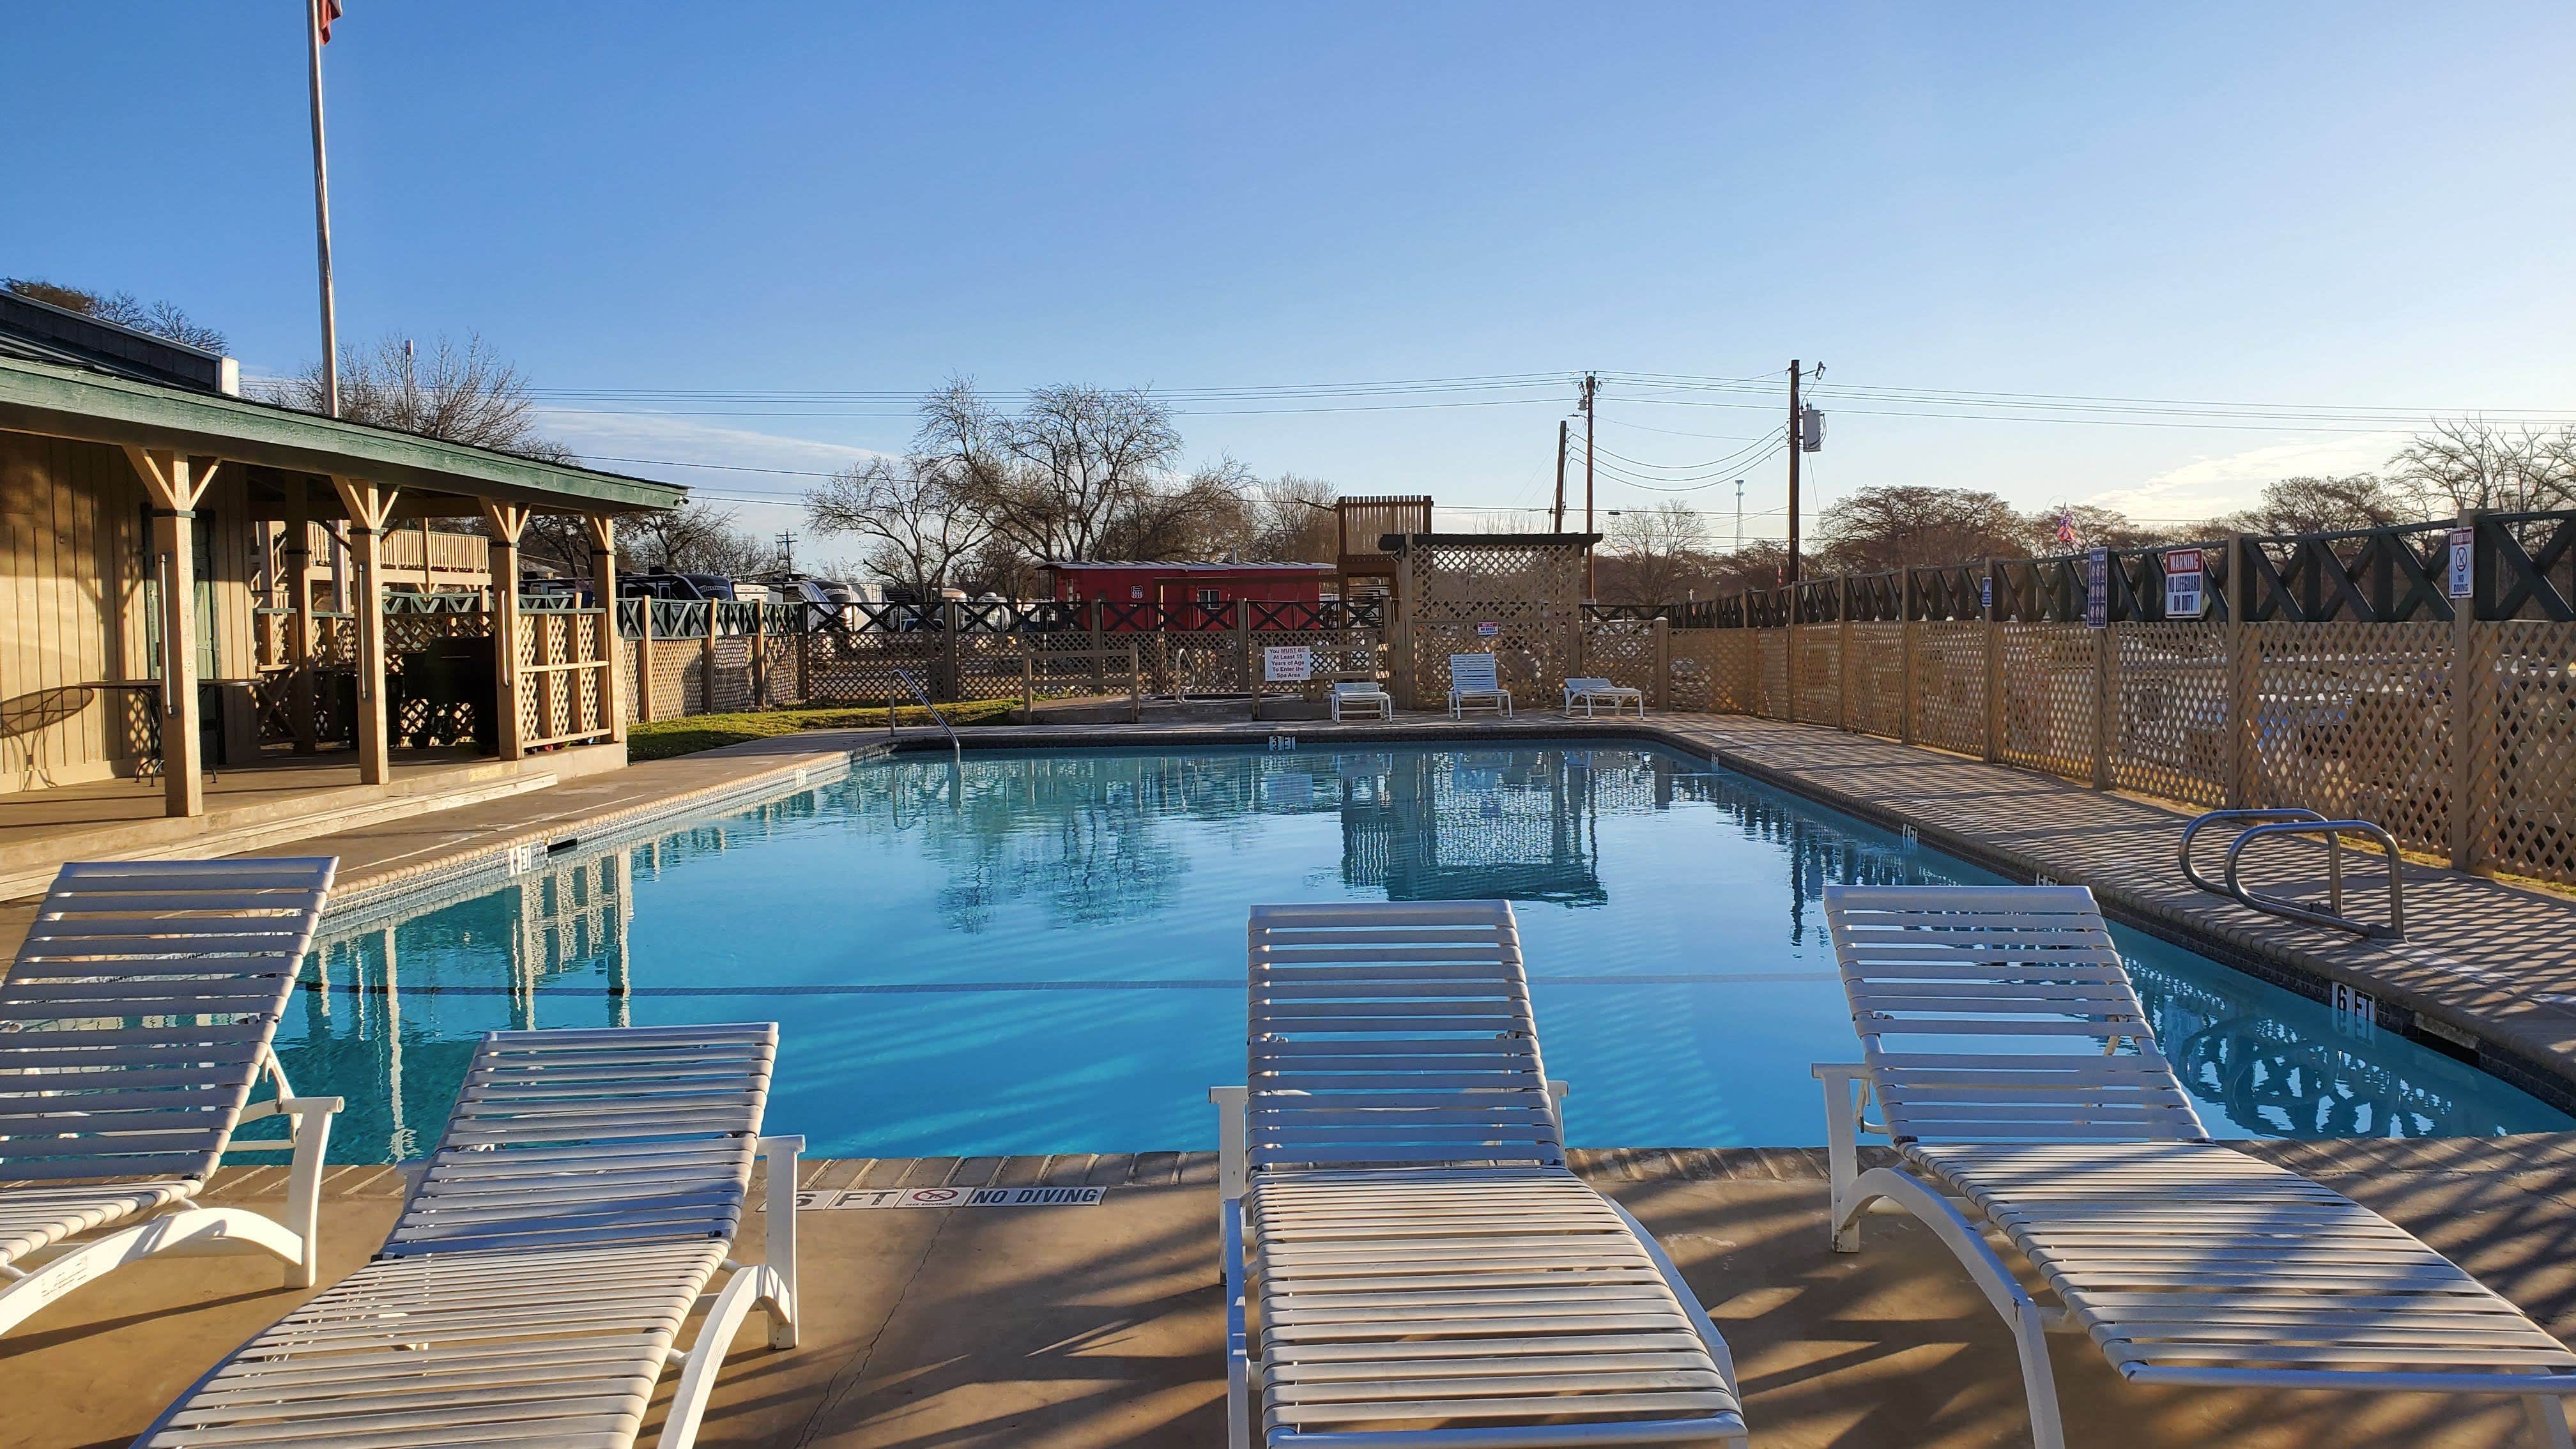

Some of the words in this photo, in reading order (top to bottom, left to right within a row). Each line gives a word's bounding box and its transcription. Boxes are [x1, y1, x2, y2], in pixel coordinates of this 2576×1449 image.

[2170, 553, 2198, 571] WARNING
[2168, 576, 2174, 593] NO
[2175, 575, 2200, 592] LIFEGUARD
[2453, 583, 2468, 592] DIVING
[2458, 574, 2464, 583] NO
[2174, 595, 2180, 611] ON
[2182, 594, 2193, 611] DUTY
[2337, 985, 2347, 1011] 6
[2354, 990, 2373, 1021] FT
[834, 1191, 898, 1207] FT
[972, 1190, 1009, 1204] NO
[1015, 1188, 1098, 1204] DIVING
